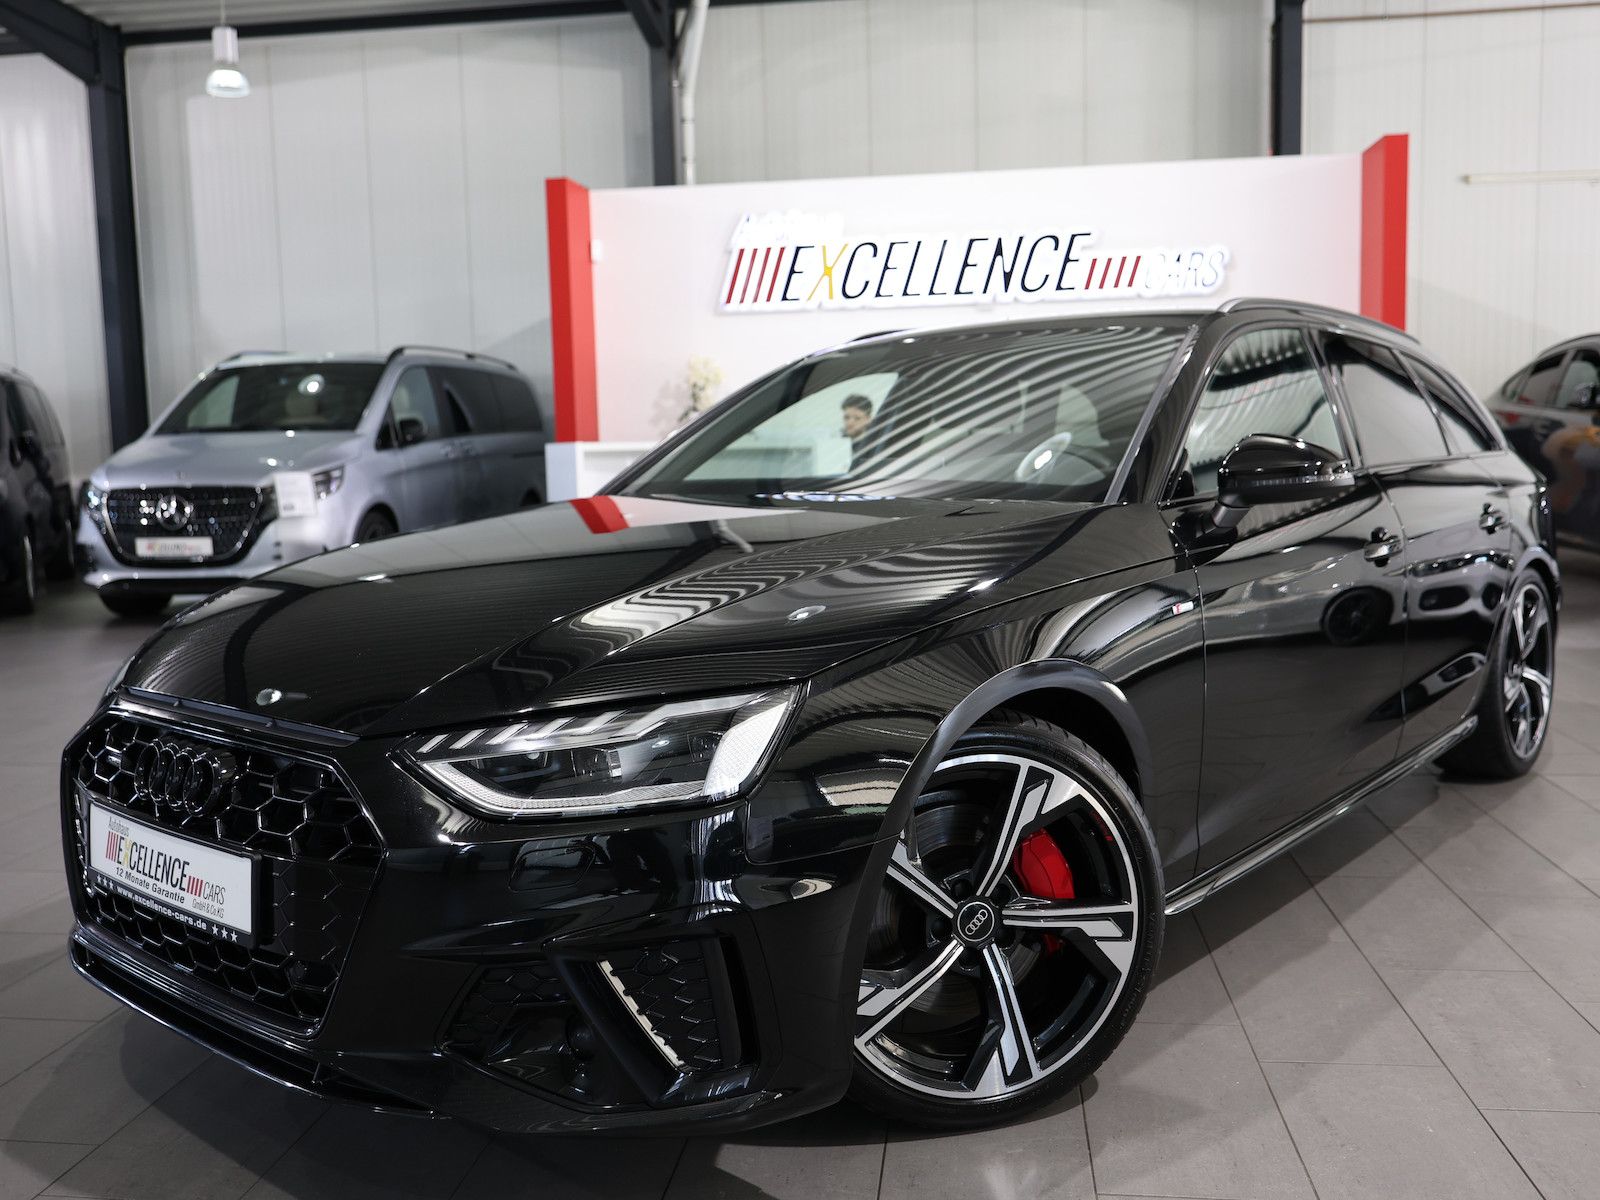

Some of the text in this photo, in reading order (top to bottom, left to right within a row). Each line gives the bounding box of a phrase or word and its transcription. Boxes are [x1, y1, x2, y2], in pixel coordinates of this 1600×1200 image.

[781, 232, 1092, 302] EXCELLENCE
[115, 866, 186, 904] 12 Monate Garantie
[116, 836, 227, 905] EXCELLENCE CARS
